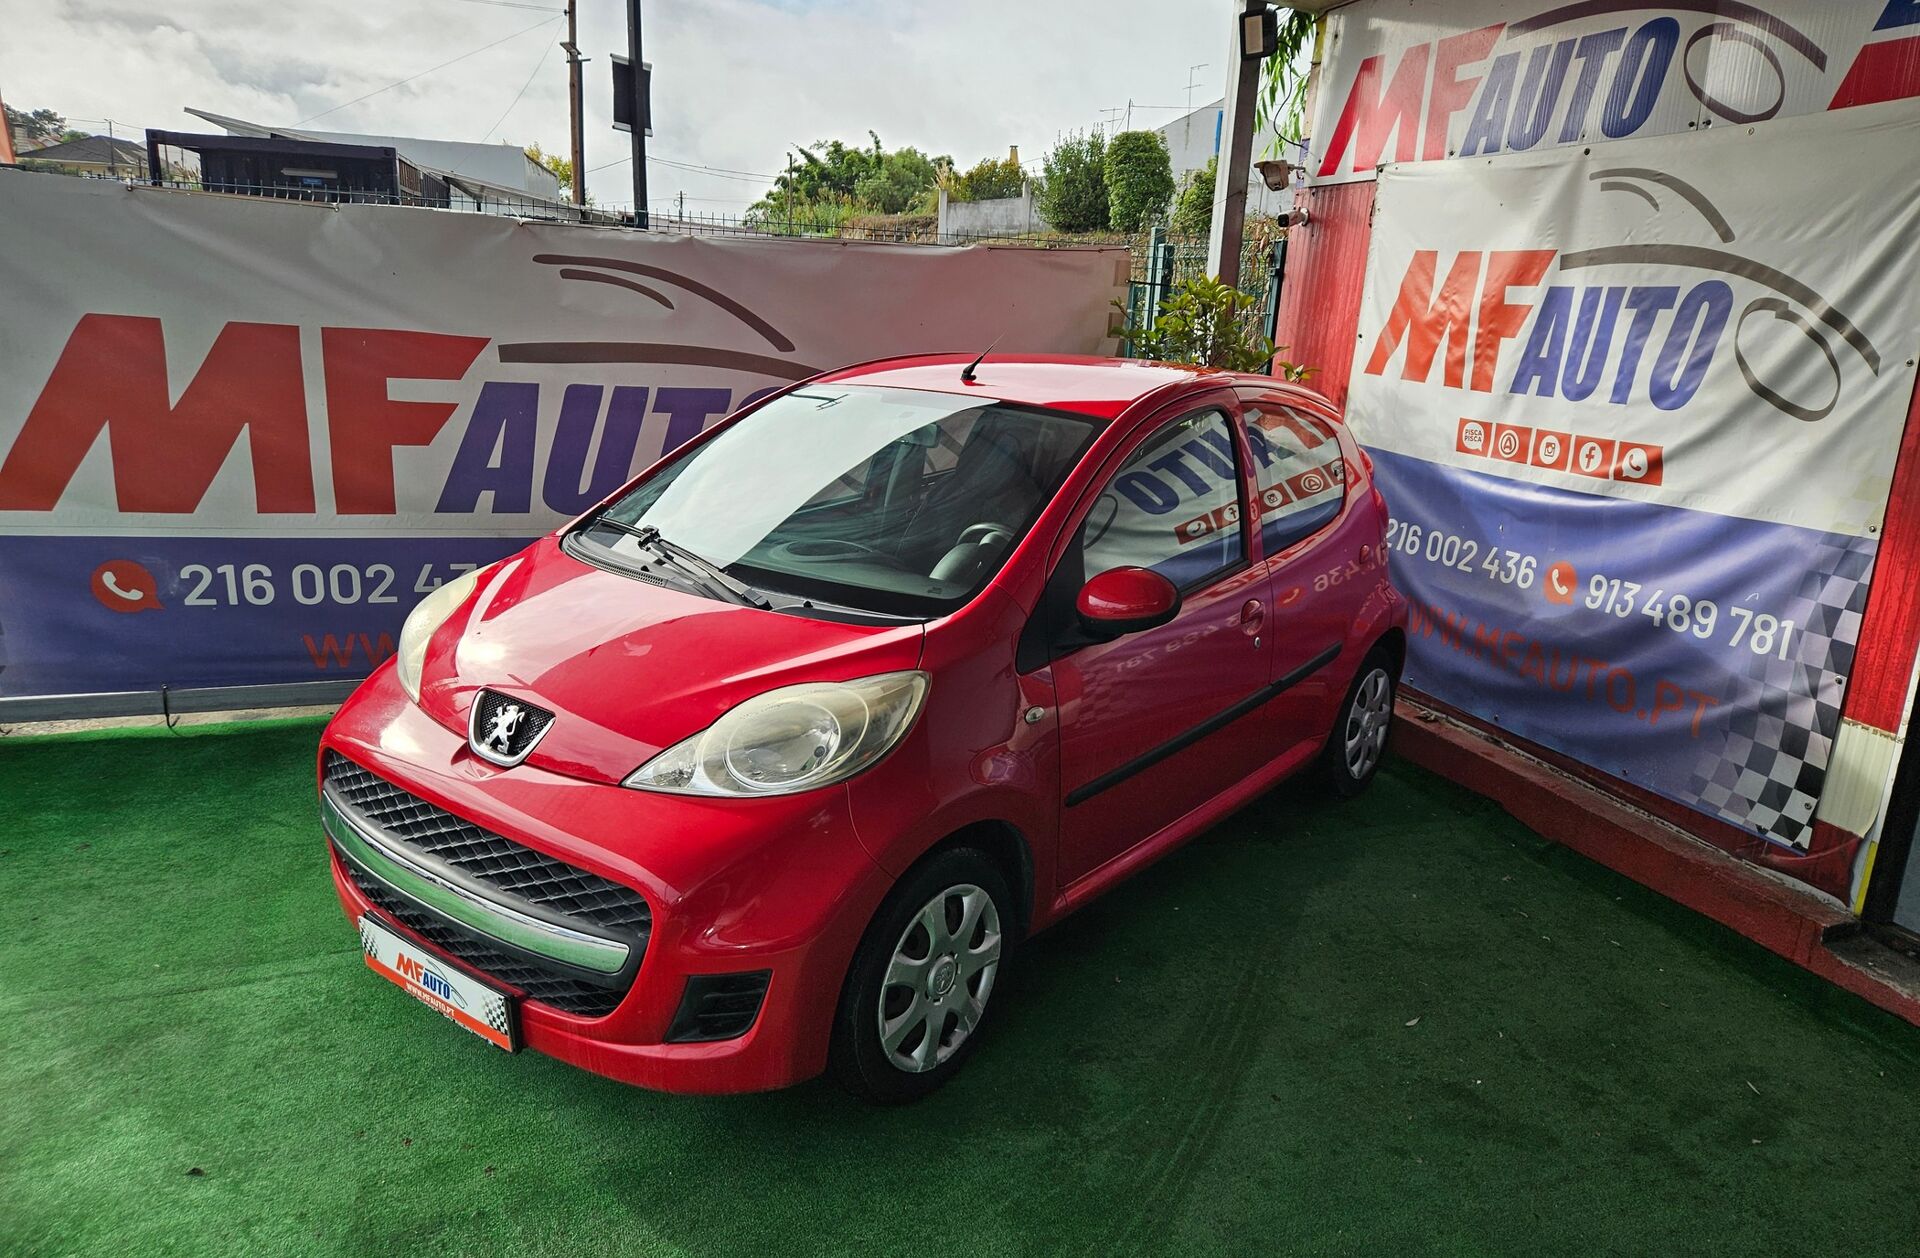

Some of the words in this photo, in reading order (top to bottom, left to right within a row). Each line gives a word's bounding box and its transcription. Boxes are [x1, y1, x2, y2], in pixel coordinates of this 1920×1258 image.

[1459, 17, 1680, 157] AUTO
[1364, 249, 1557, 393] MF
[1509, 280, 1734, 411] AUTO
[1464, 435, 1482, 443] PISCA
[1465, 428, 1482, 437] PISCA
[180, 564, 275, 606] 216
[291, 563, 398, 605] 002
[1386, 518, 1422, 555] 216
[1426, 531, 1478, 573] 002
[1481, 547, 1537, 589] 436
[1585, 574, 1642, 618] 913
[1641, 589, 1718, 639] 489
[1728, 606, 1795, 661] 781
[396, 952, 424, 984] MF
[423, 971, 451, 1000] AUTO
